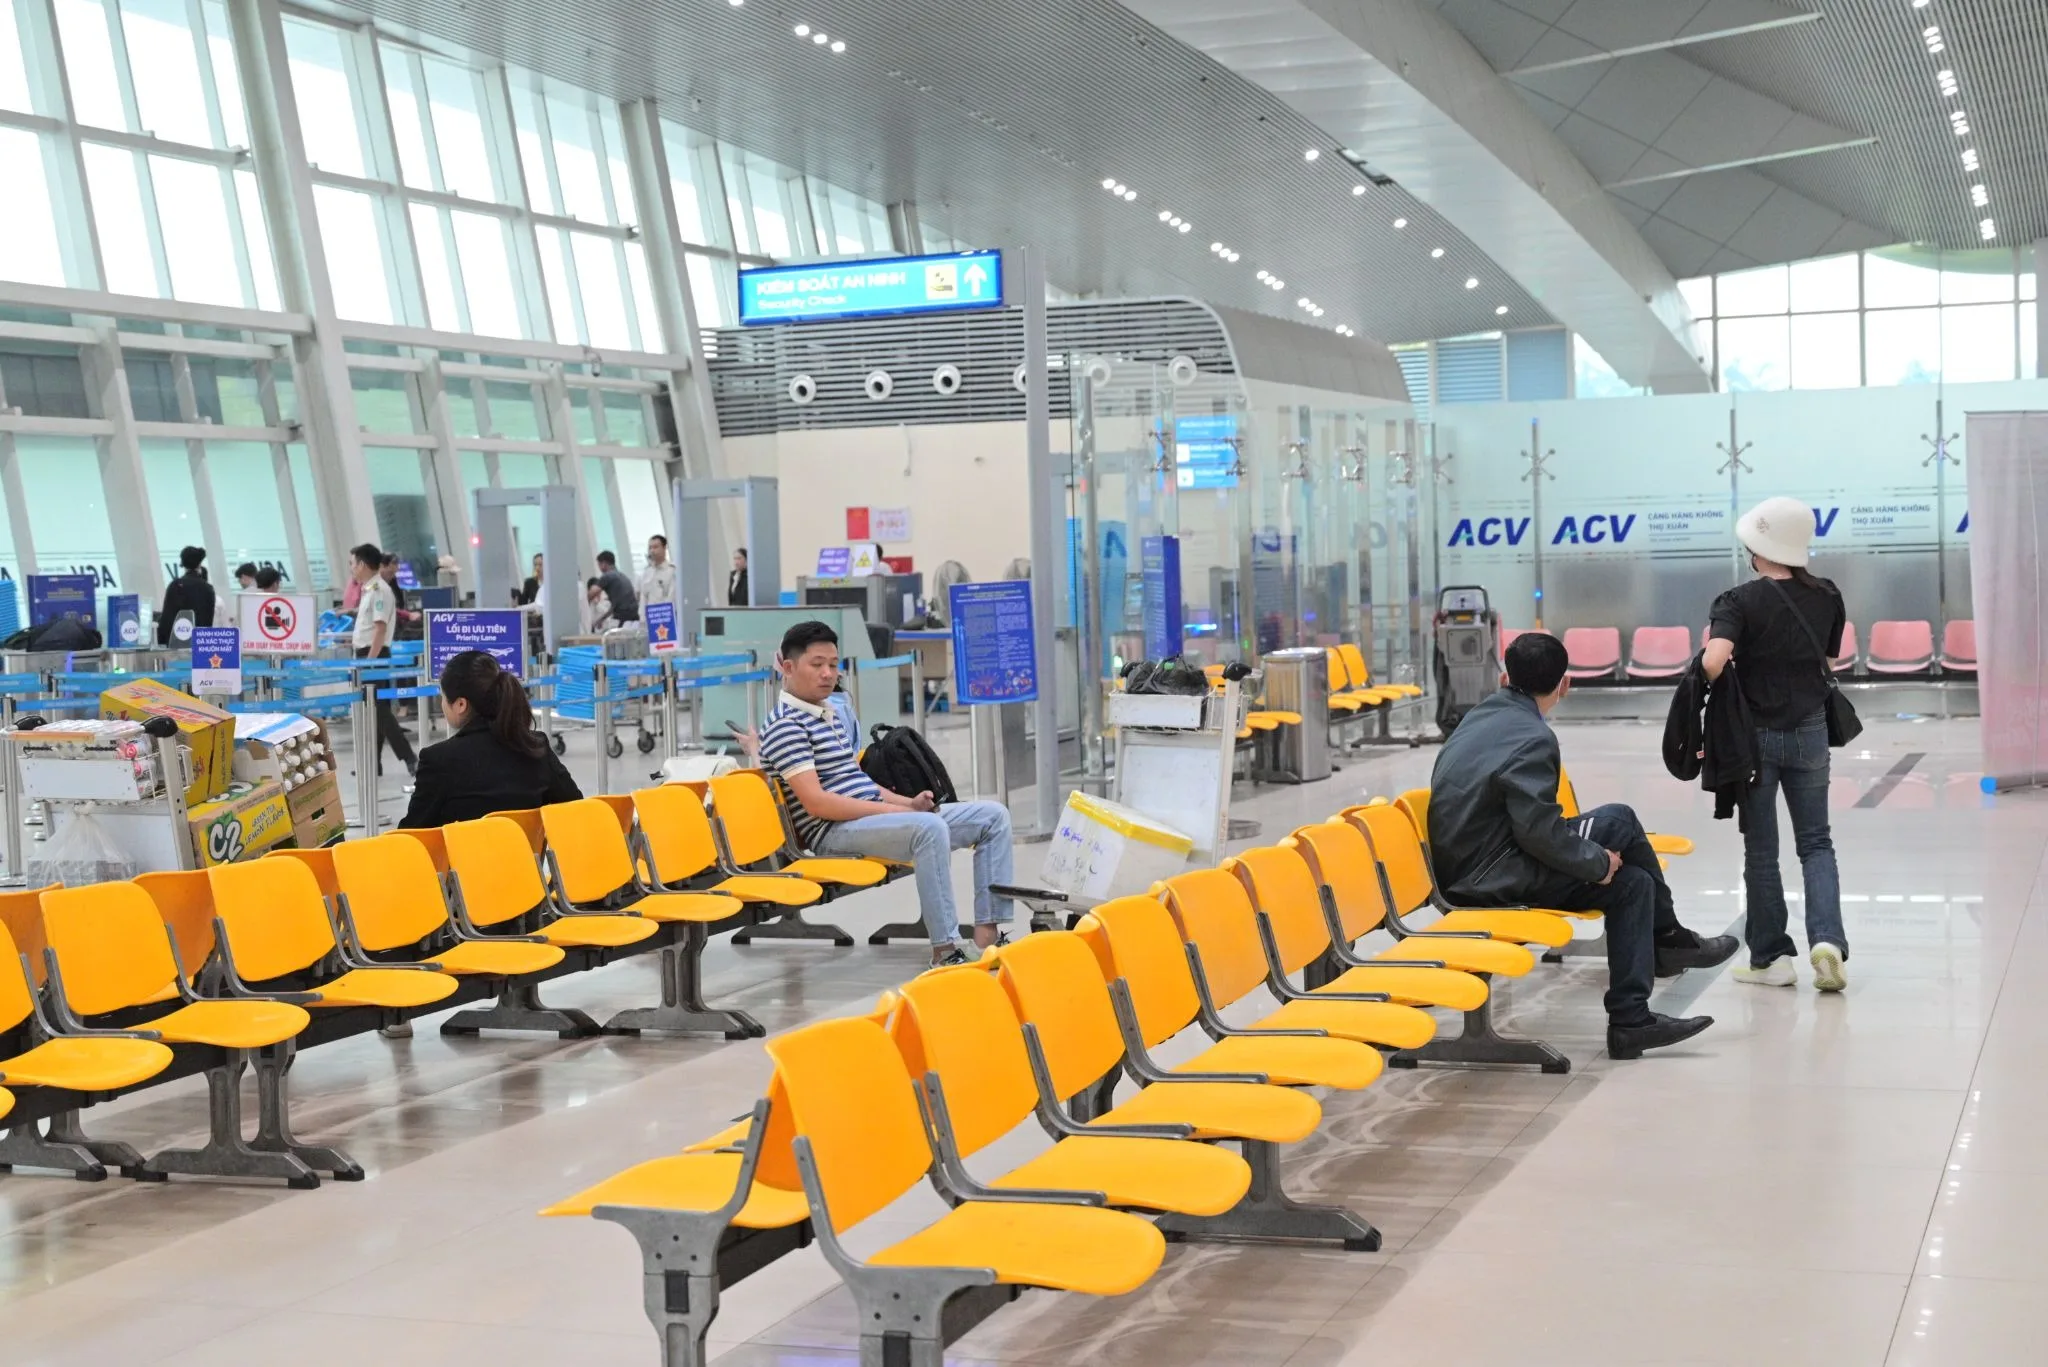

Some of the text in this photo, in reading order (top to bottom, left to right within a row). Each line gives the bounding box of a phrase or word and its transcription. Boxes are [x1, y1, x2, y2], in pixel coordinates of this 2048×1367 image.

[842, 275, 865, 289] AN
[868, 272, 906, 286] NINH
[757, 295, 845, 310] Security Check
[1901, 503, 1931, 513] KHÔNG
[1448, 517, 1531, 547] ACV
[1551, 514, 1637, 545] ACV
[433, 613, 455, 622] ACV
[446, 622, 460, 633] LỐI
[486, 623, 507, 633] TIÊN
[456, 634, 480, 642] Priority
[210, 821, 243, 861] C2
